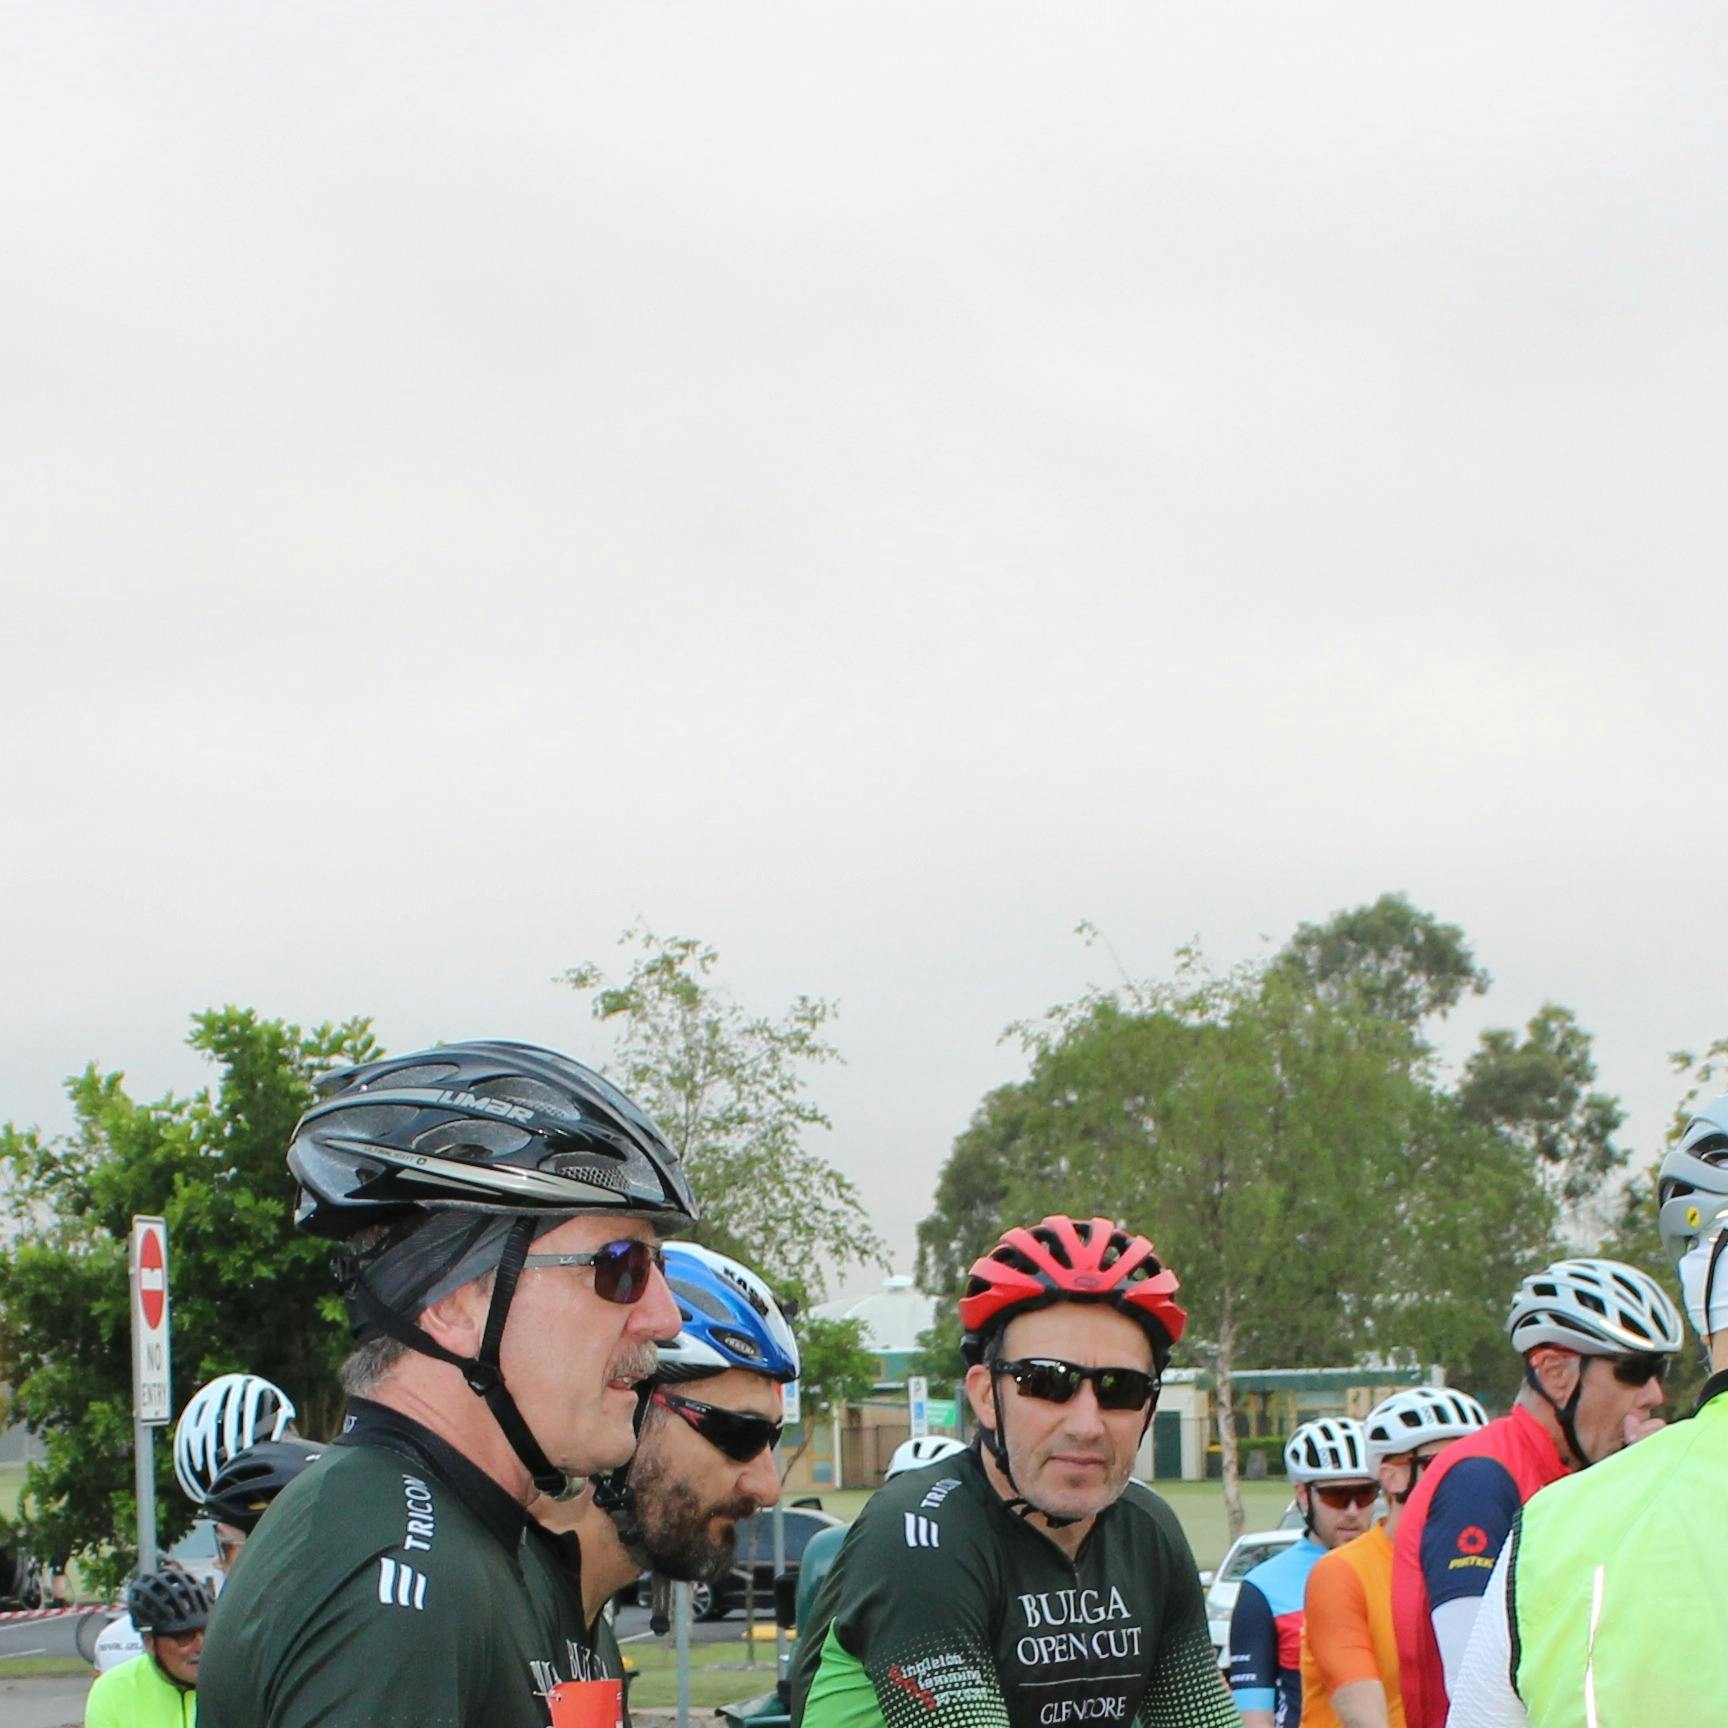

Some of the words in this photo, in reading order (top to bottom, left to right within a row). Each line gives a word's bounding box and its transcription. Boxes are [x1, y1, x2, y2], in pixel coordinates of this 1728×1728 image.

[437, 1090, 535, 1124] LIMAR
[403, 1473, 434, 1551] TRICON
[1017, 1586, 1131, 1629] BULGA
[1017, 1634, 1087, 1667] OPEN
[1091, 1627, 1141, 1660] CUT
